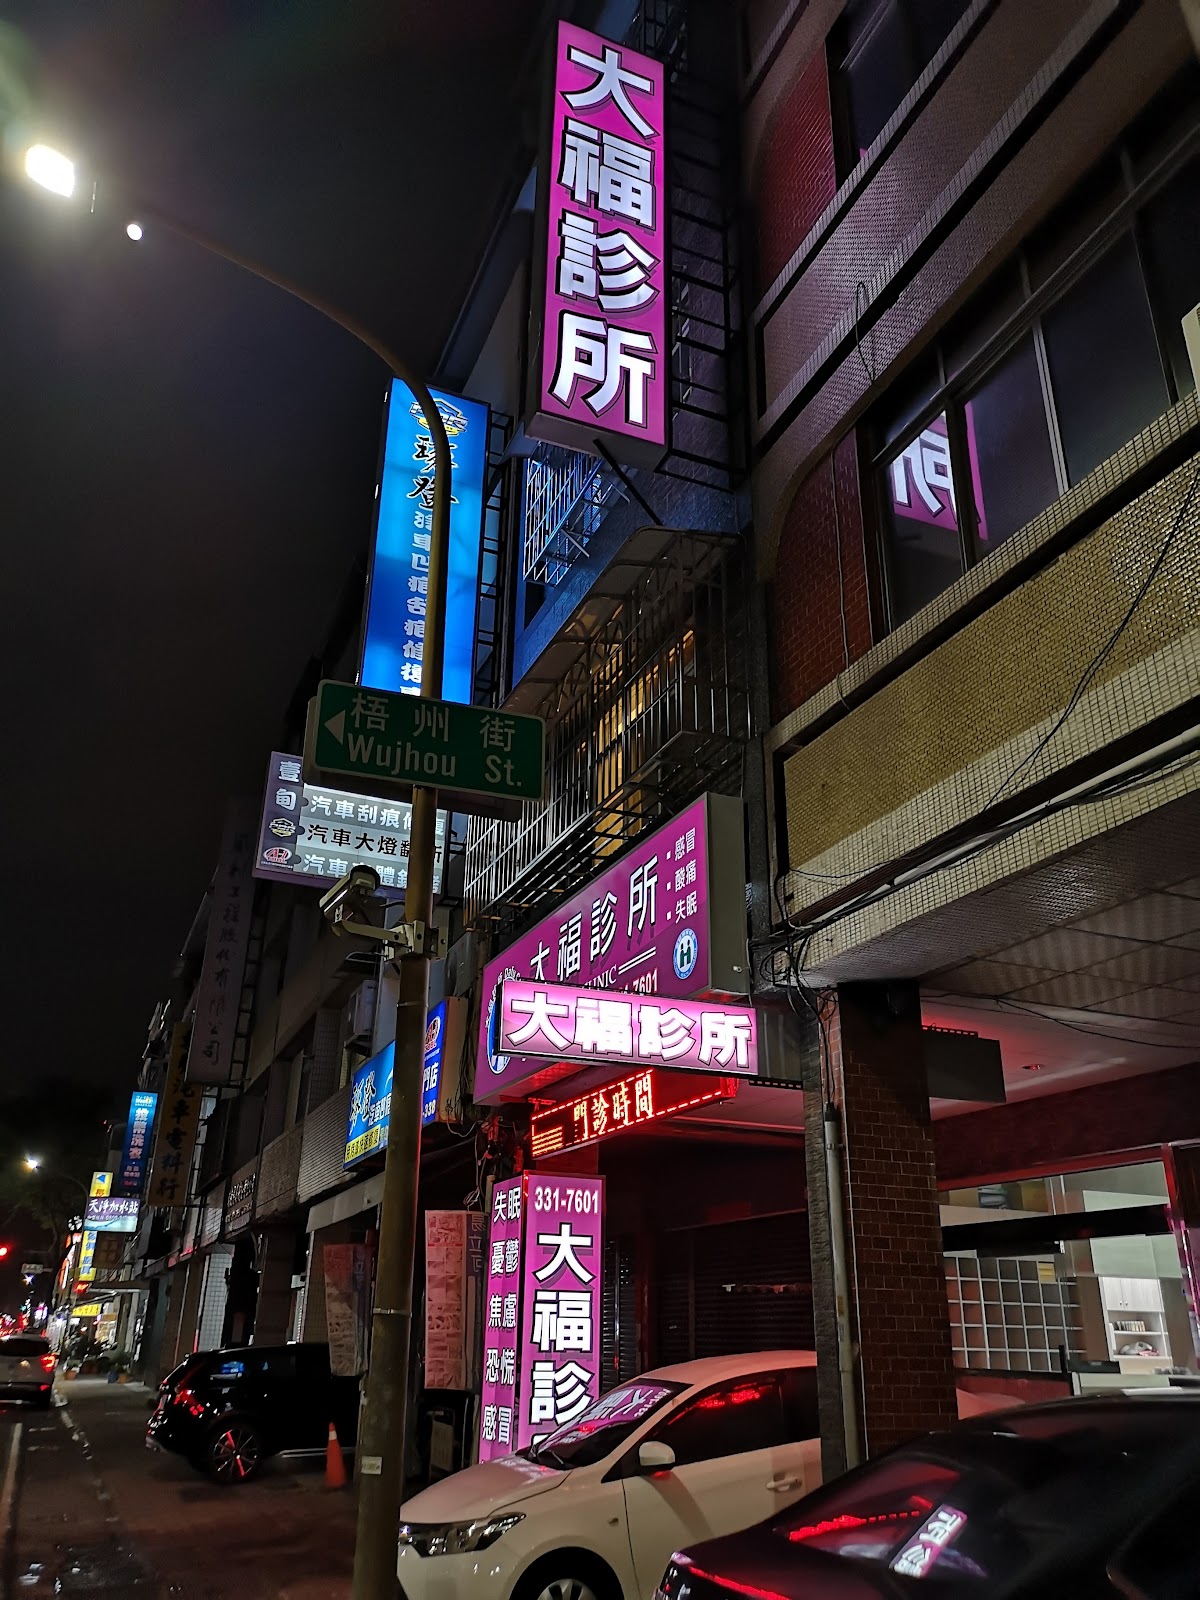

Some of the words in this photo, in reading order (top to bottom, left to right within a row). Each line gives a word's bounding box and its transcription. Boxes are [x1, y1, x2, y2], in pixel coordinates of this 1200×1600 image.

[549, 46, 661, 428] 大福診所
[351, 693, 515, 752] 梧州街
[347, 732, 456, 777] Wujhou
[484, 755, 522, 786] St.
[674, 827, 696, 861] 感冒
[674, 859, 697, 893] 酸痛
[530, 854, 659, 983] 大福診所
[674, 891, 697, 924] 失眠
[507, 991, 754, 1068] 大福診所
[572, 1074, 654, 1140] 門診時間
[493, 1186, 521, 1223] 失眠
[535, 1186, 599, 1214] 331-7601
[490, 1239, 519, 1275] 憂鬱
[487, 1293, 517, 1330] 焦慮
[529, 1221, 597, 1451] 大福診
[485, 1348, 515, 1386] 恐慌
[482, 1404, 512, 1445] 感冒
